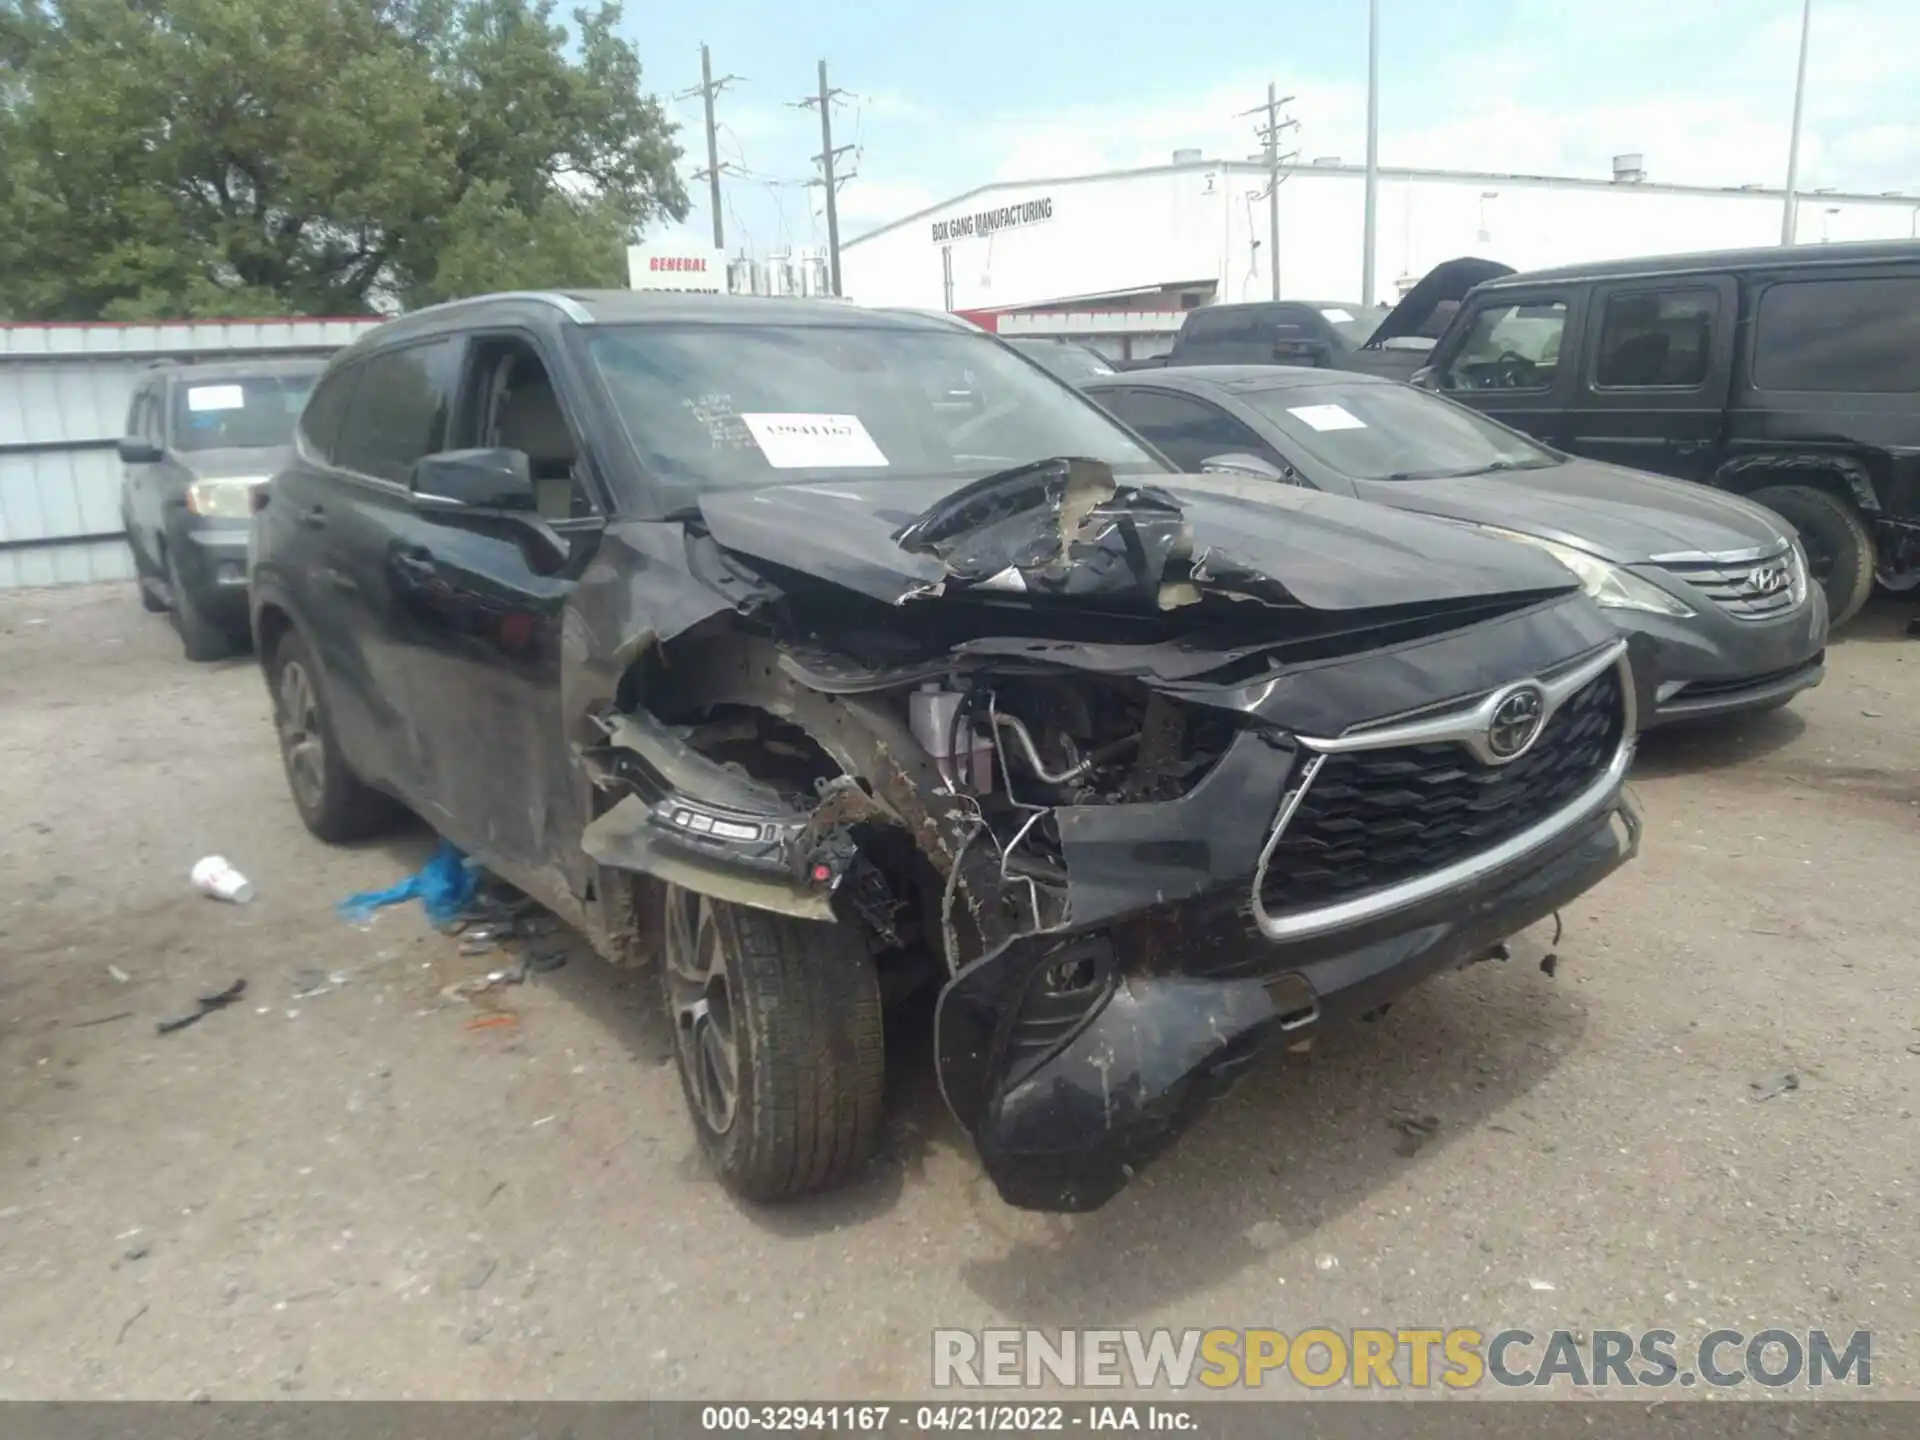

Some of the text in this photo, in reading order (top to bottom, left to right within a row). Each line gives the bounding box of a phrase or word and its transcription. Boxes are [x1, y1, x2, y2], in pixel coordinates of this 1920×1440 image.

[932, 197, 1052, 242] BOX GANG MANUFACTURING
[649, 257, 708, 272] GENERAL
